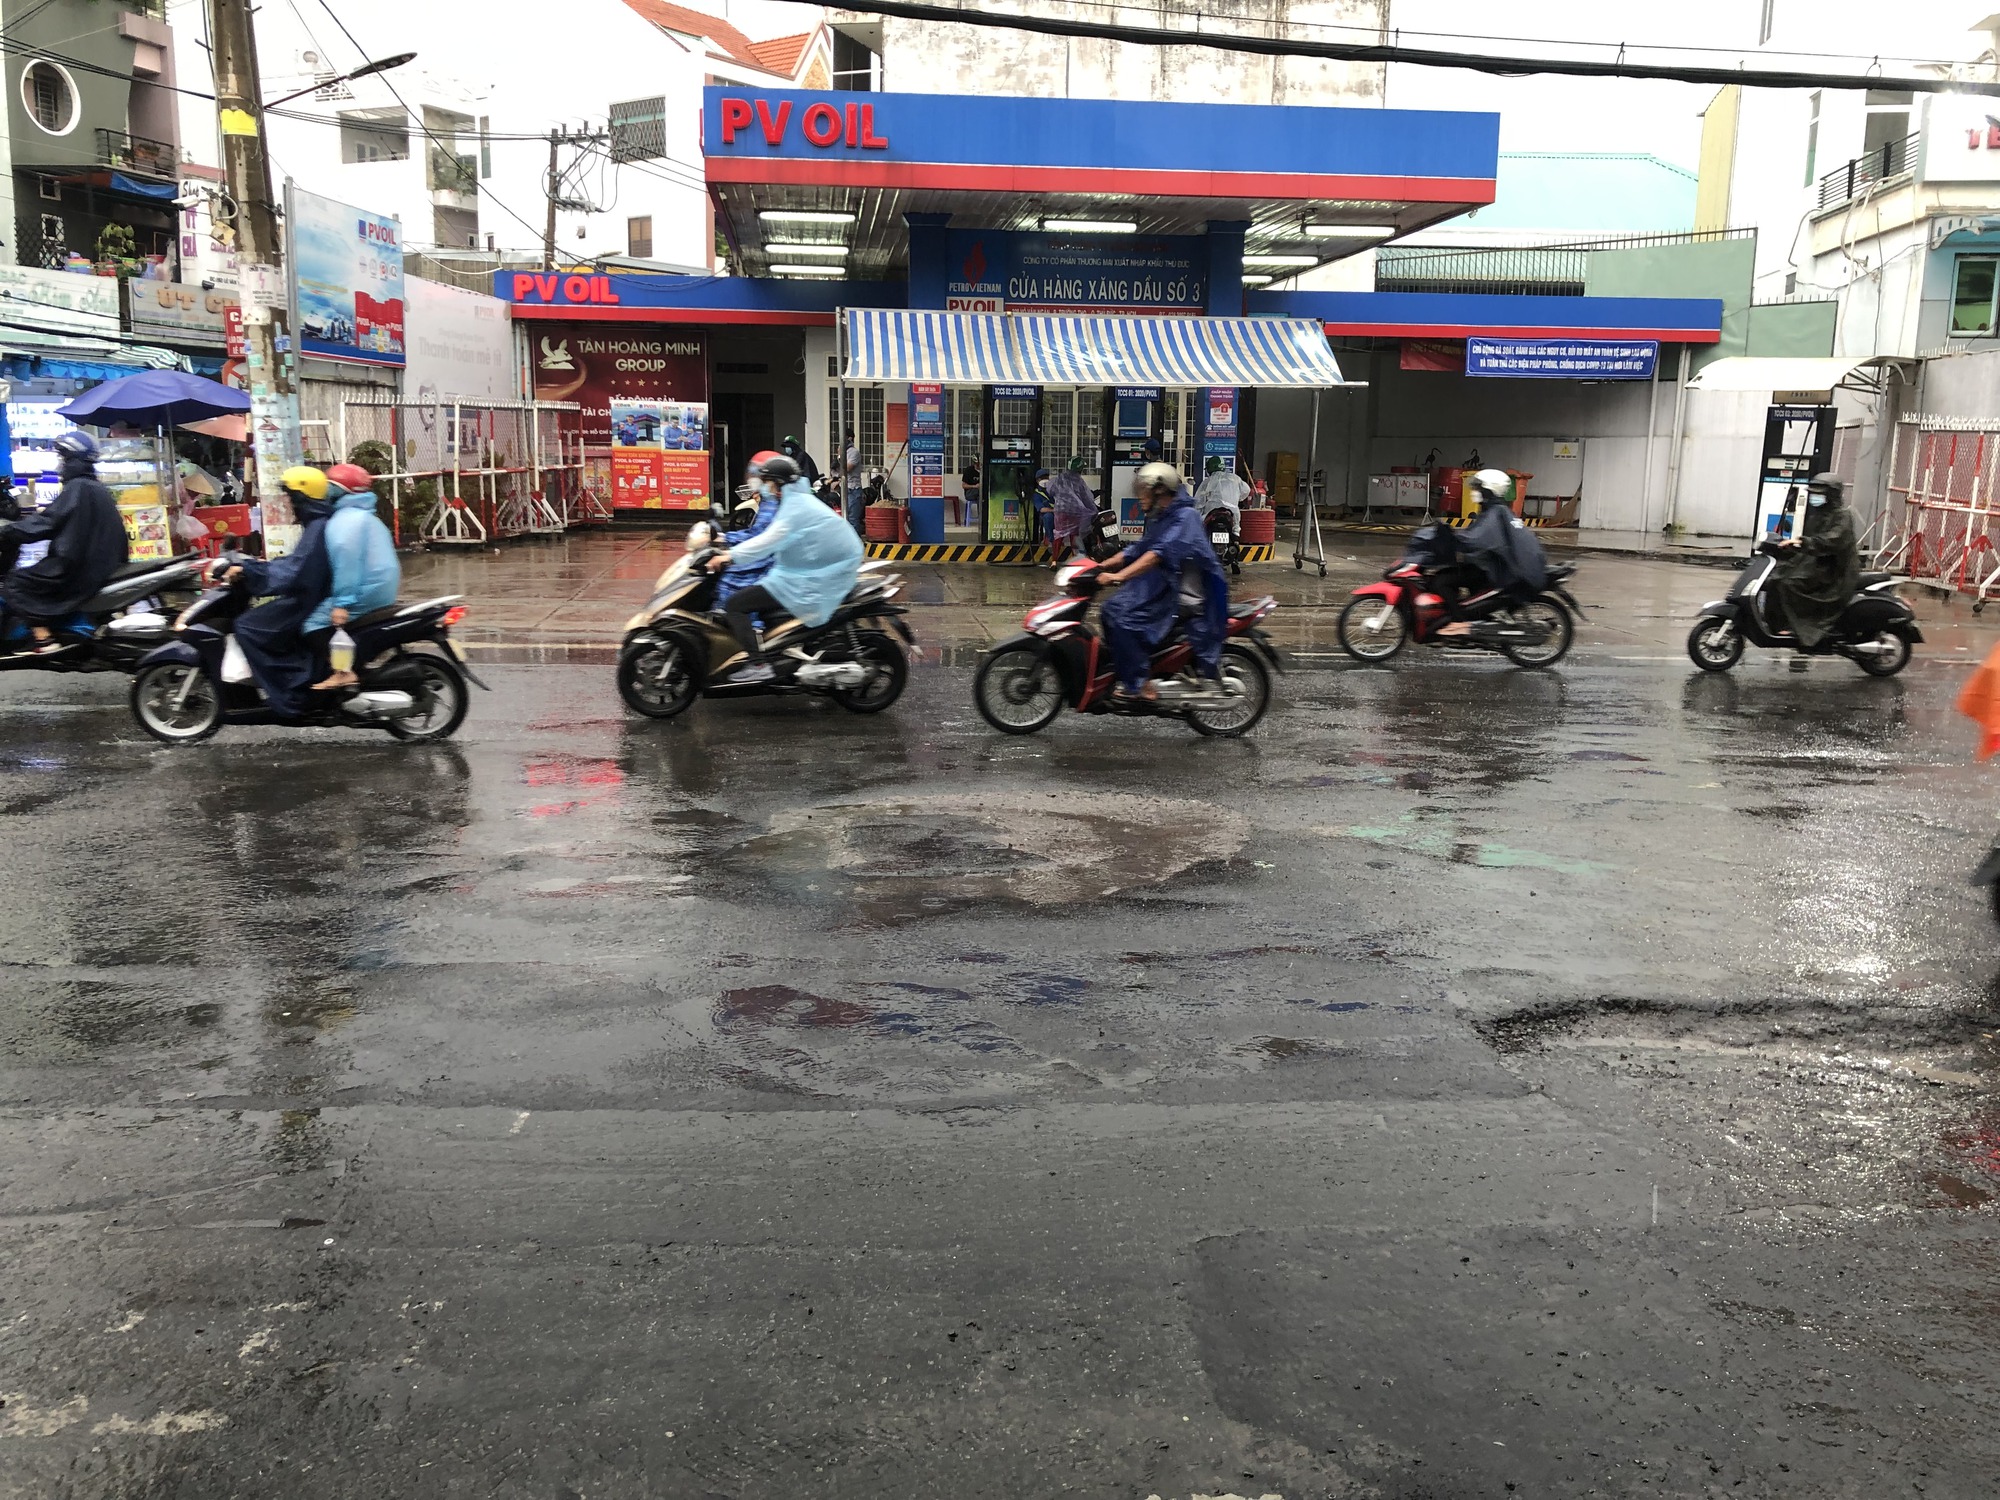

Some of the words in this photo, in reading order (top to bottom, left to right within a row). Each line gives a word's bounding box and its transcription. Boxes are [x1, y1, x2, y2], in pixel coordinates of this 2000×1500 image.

[721, 98, 793, 145] PV
[802, 102, 888, 149] OIL
[368, 222, 396, 245] PVOIL
[513, 274, 558, 301] PV
[564, 276, 619, 303] OIL
[949, 282, 1001, 293] PETROVIETNAM
[1009, 271, 1038, 299] CỬA
[1044, 273, 1082, 300] HÀNG
[1088, 276, 1127, 301] XĂNG
[1133, 275, 1161, 301] DẦU
[1167, 274, 1188, 302] SỐ
[1192, 282, 1200, 302] 3
[577, 337, 605, 354] TÂN
[609, 338, 661, 355] HOÀNG
[665, 342, 700, 356] MINH
[1537, 346, 1547, 355] CÁC
[1594, 347, 1600, 356] AN
[615, 359, 666, 372] GROUP
[1508, 358, 1518, 368] CÁC
[581, 406, 596, 417] TÀI
